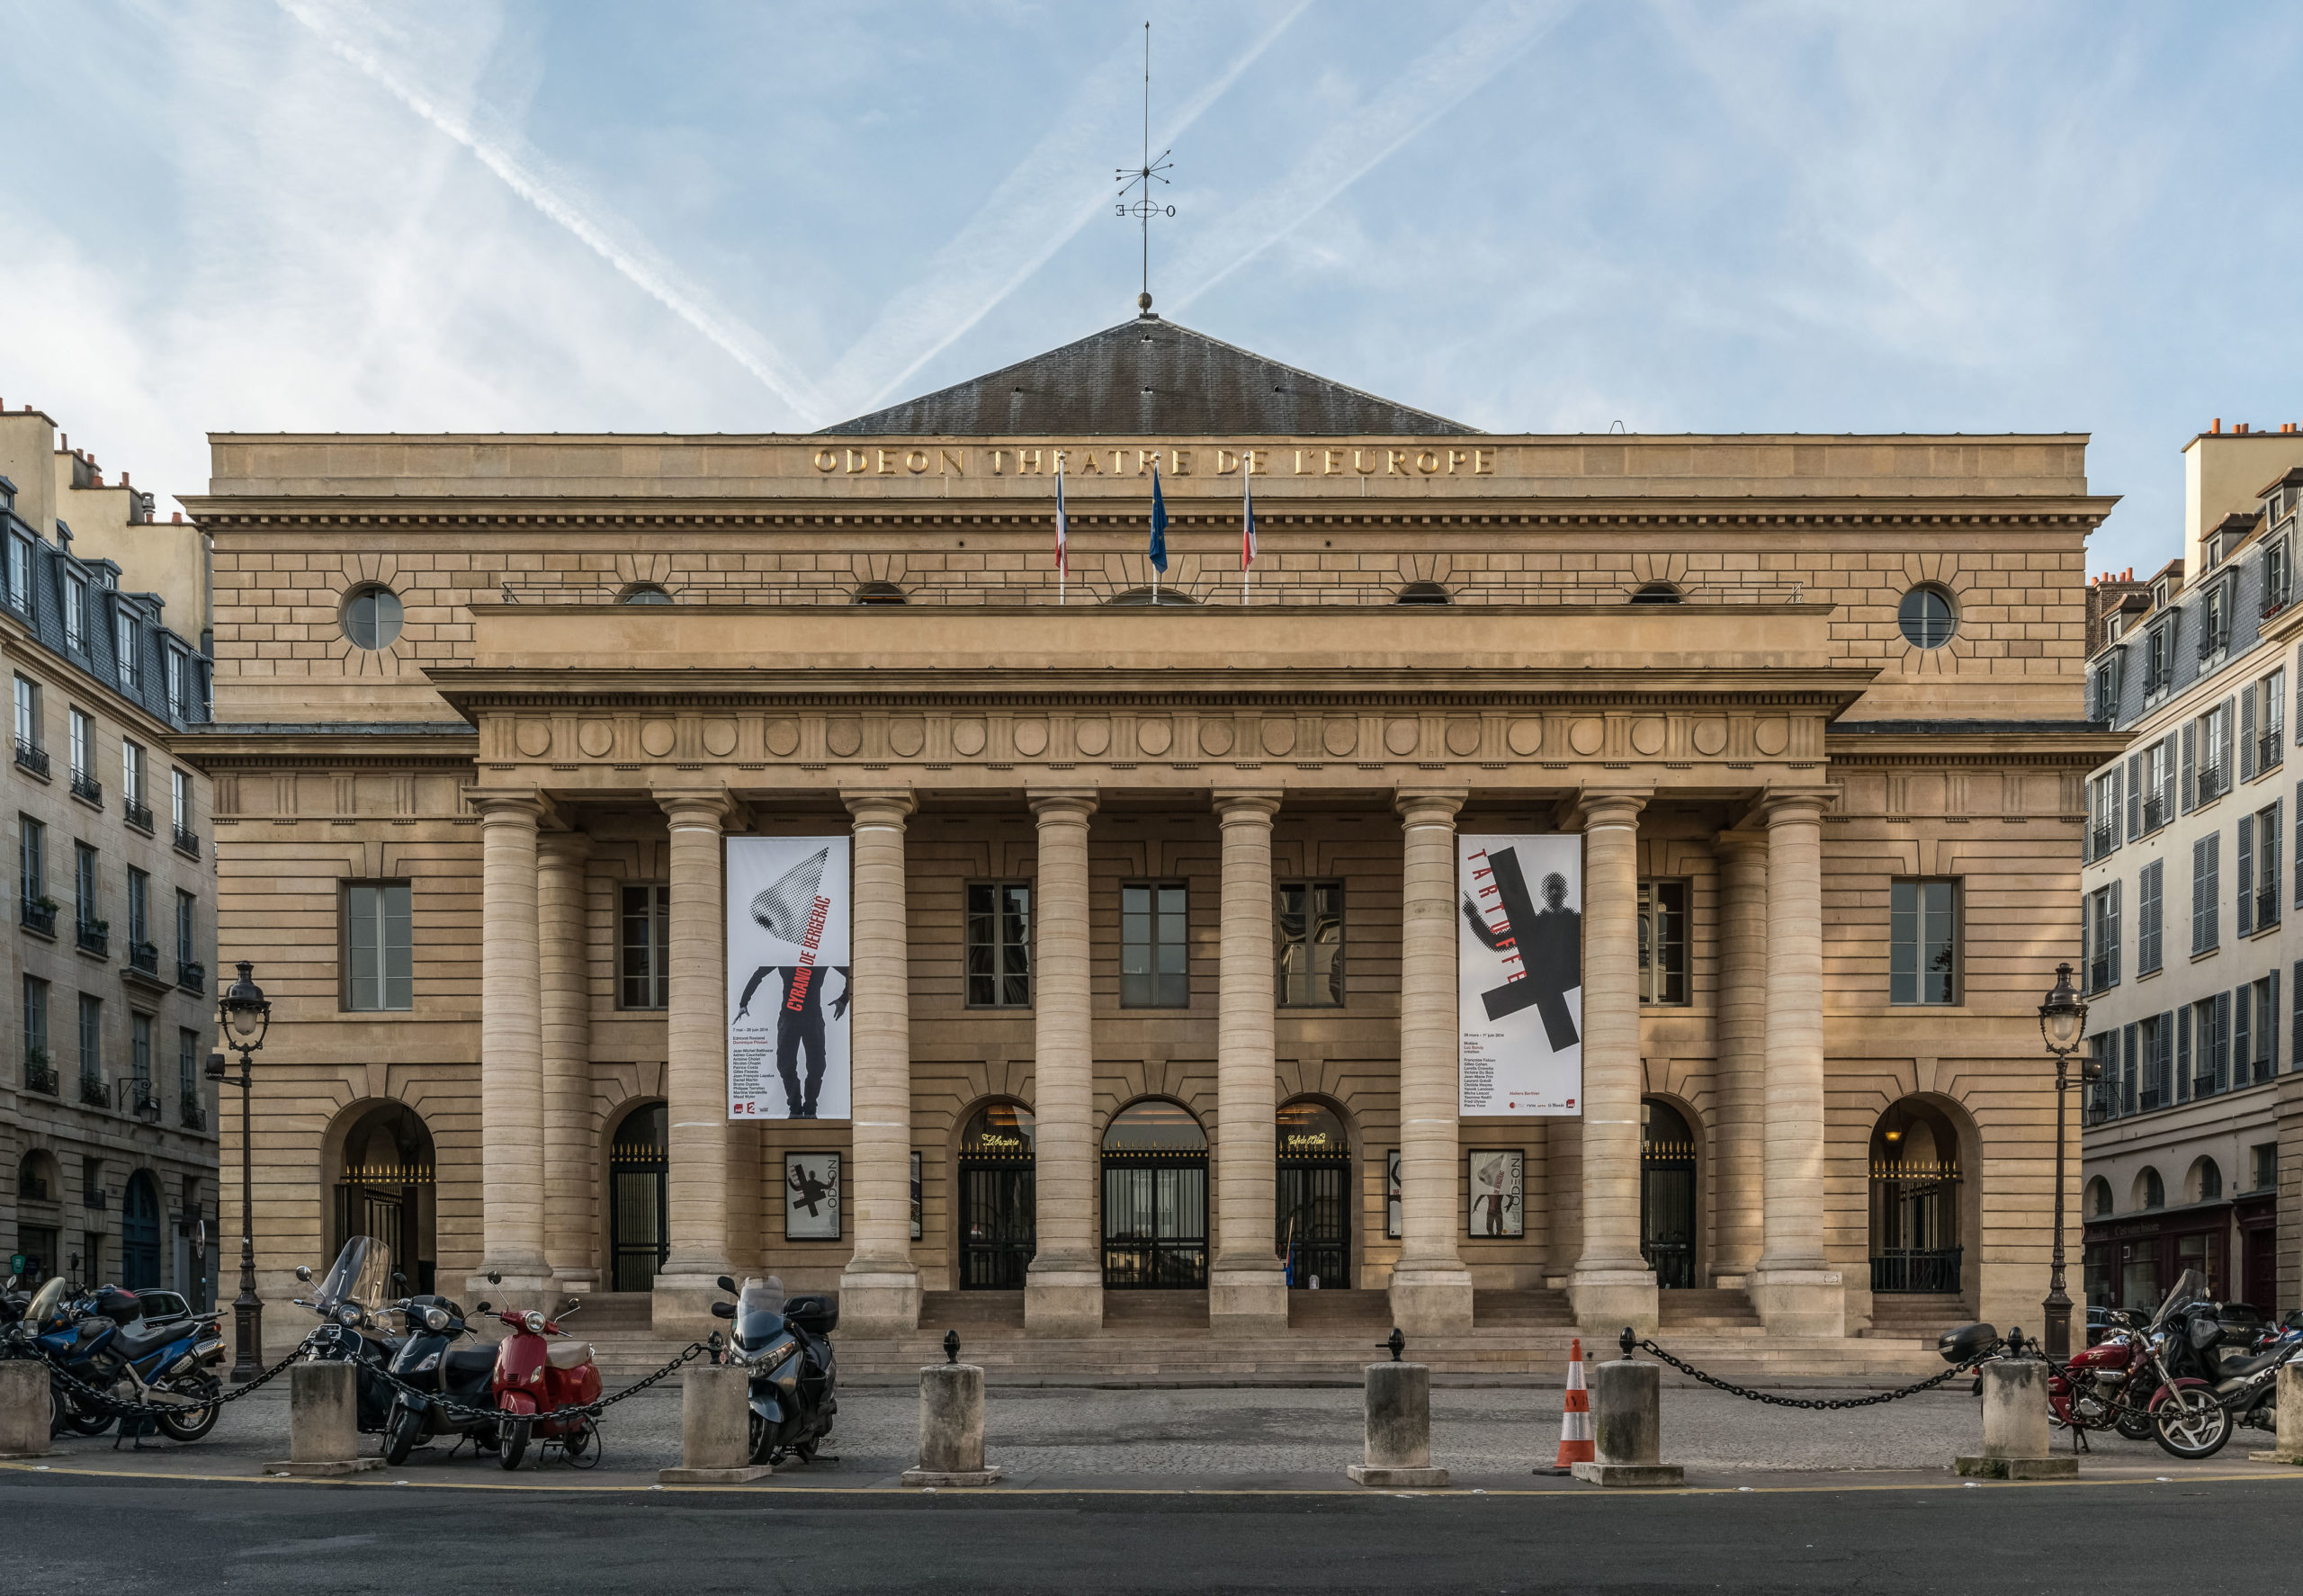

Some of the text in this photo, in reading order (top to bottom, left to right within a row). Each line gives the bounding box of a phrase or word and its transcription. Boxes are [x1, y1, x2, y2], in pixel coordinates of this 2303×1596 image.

[814, 449, 1495, 476] ODEON THEATRE DE L'EUROPE
[1467, 848, 1528, 983] TARTUFFE
[786, 895, 831, 1012] CYRANO DE BERGERAC
[981, 1133, 1019, 1146] Librairie
[1511, 1158, 1521, 1206] ODEON
